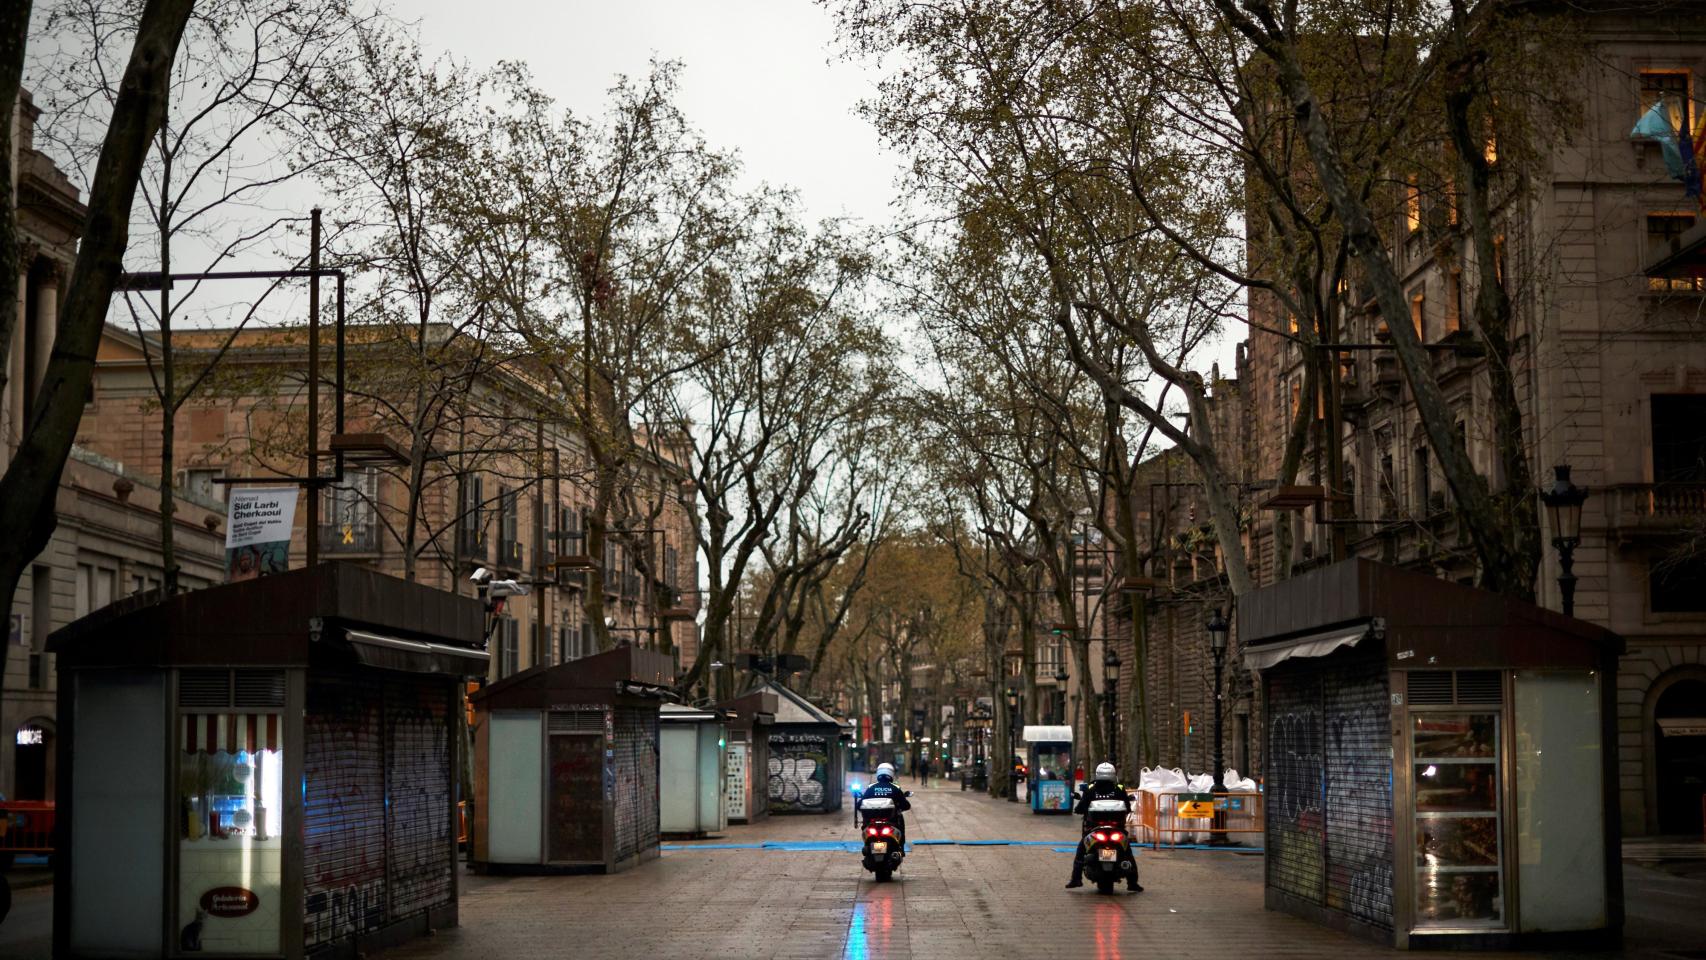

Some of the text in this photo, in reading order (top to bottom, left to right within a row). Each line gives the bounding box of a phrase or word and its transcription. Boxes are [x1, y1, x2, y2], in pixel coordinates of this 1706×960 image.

[234, 501, 279, 511] Sidi Larbi
[233, 508, 282, 520] Cherkaoui
